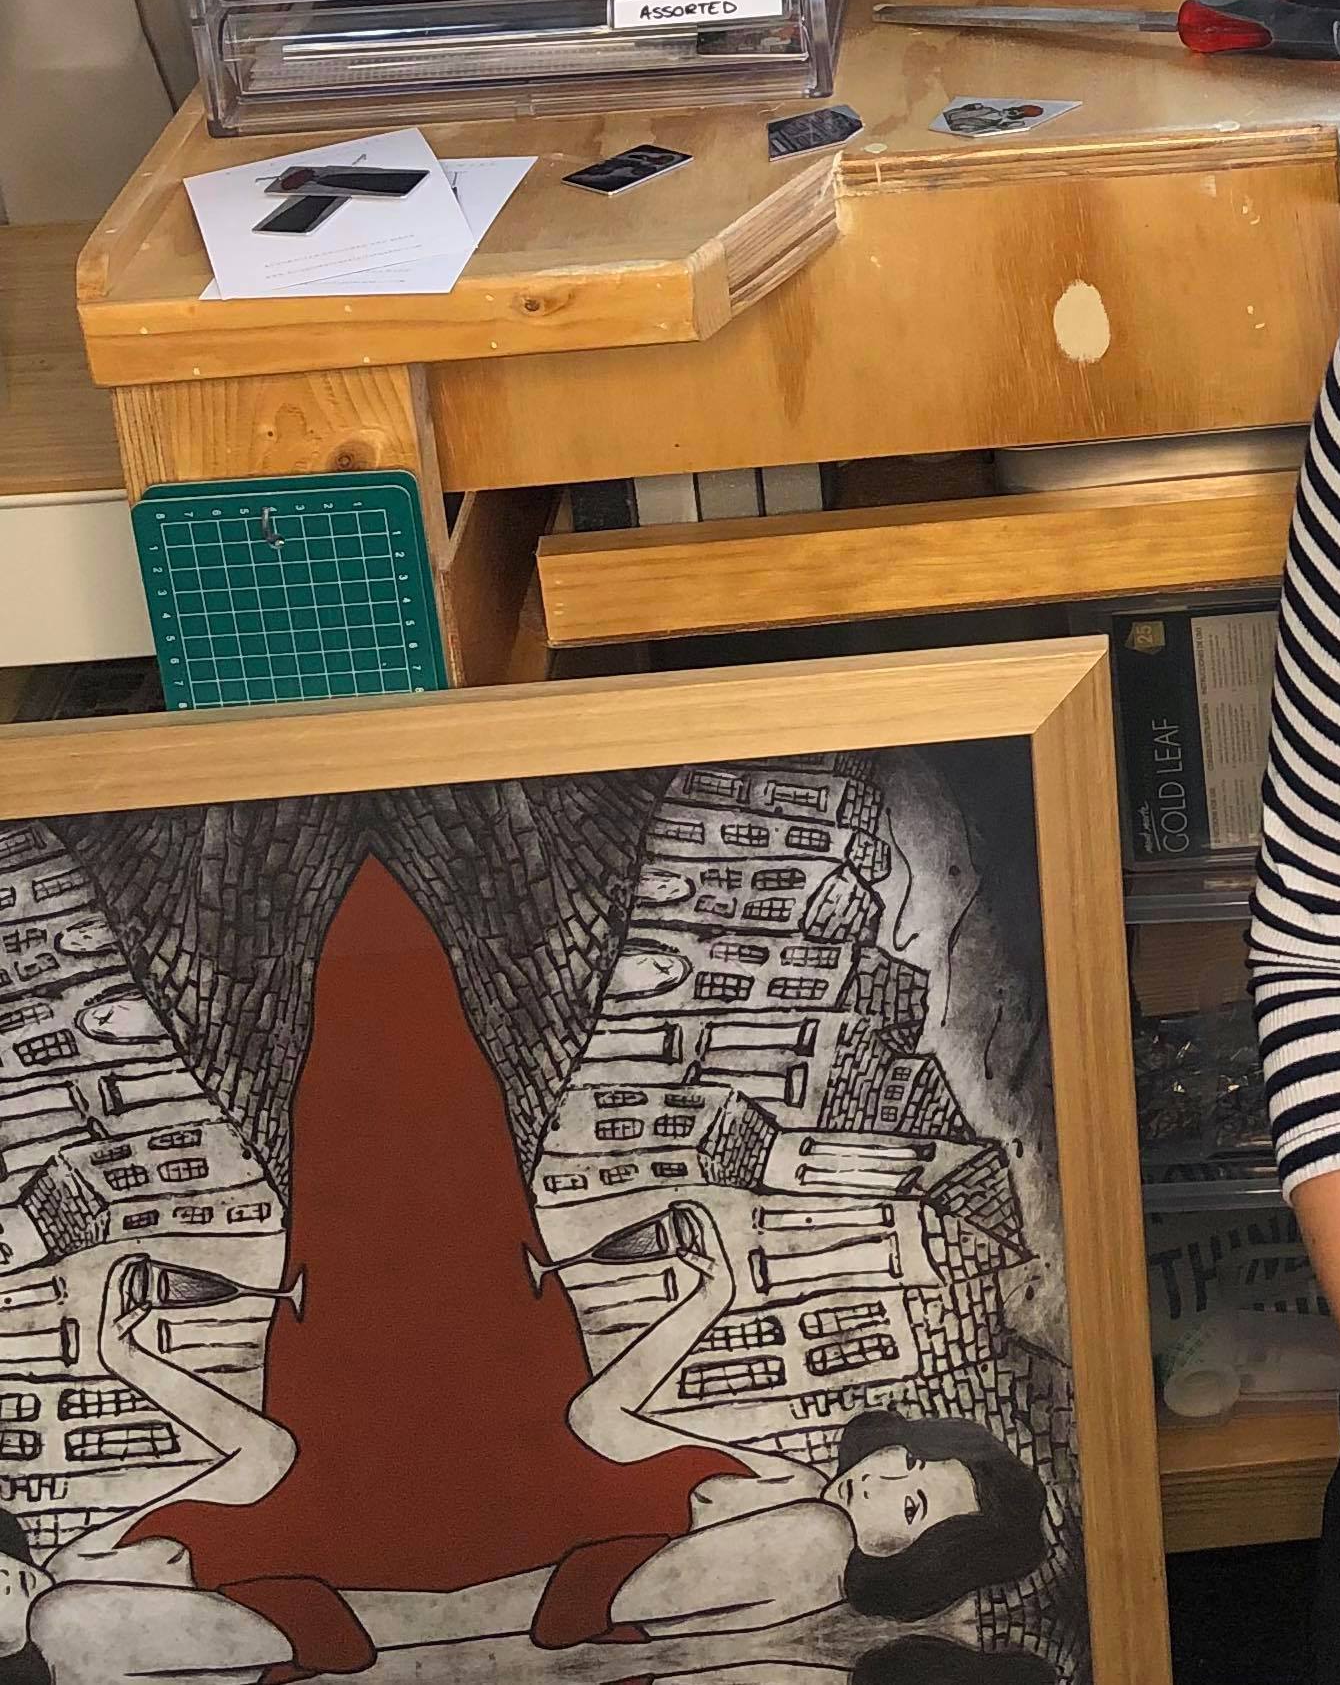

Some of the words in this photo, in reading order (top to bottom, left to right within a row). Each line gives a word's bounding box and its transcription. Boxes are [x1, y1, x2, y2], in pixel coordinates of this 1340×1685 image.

[639, 1, 738, 19] ASSORTED
[1136, 624, 1153, 644] 25
[1152, 718, 1183, 774] LEAF
[1158, 781, 1190, 853] GOLD
